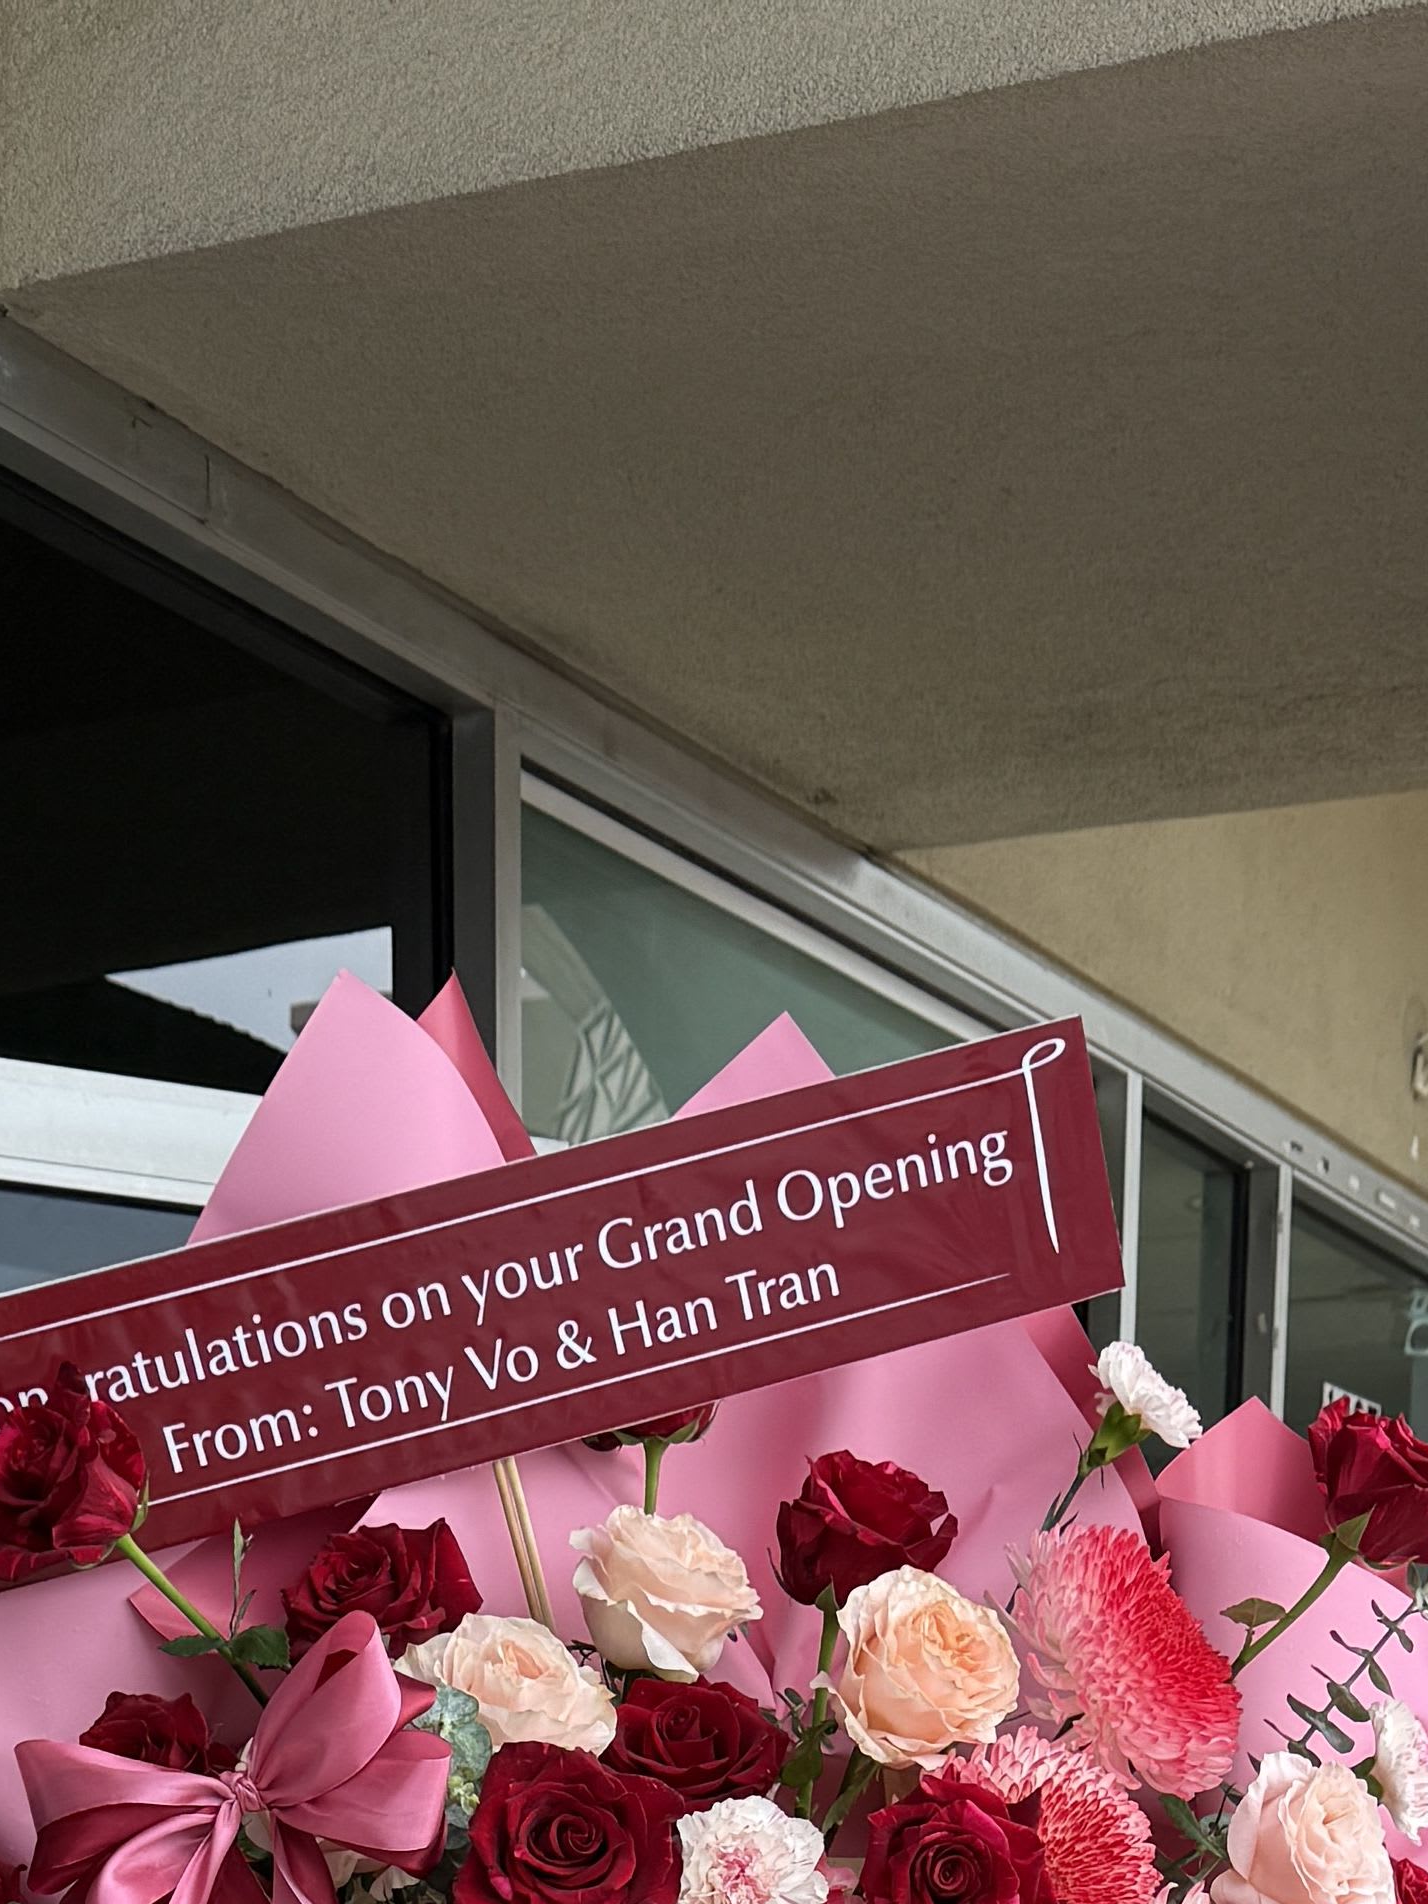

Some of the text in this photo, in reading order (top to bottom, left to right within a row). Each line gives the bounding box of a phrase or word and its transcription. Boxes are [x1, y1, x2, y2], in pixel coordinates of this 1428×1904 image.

[381, 1281, 452, 1329] on
[460, 1242, 584, 1327] your
[597, 1178, 764, 1270] Grand
[776, 1129, 1014, 1229] Opening
[162, 1261, 841, 1474] From: Tony Vo & Han Tran
